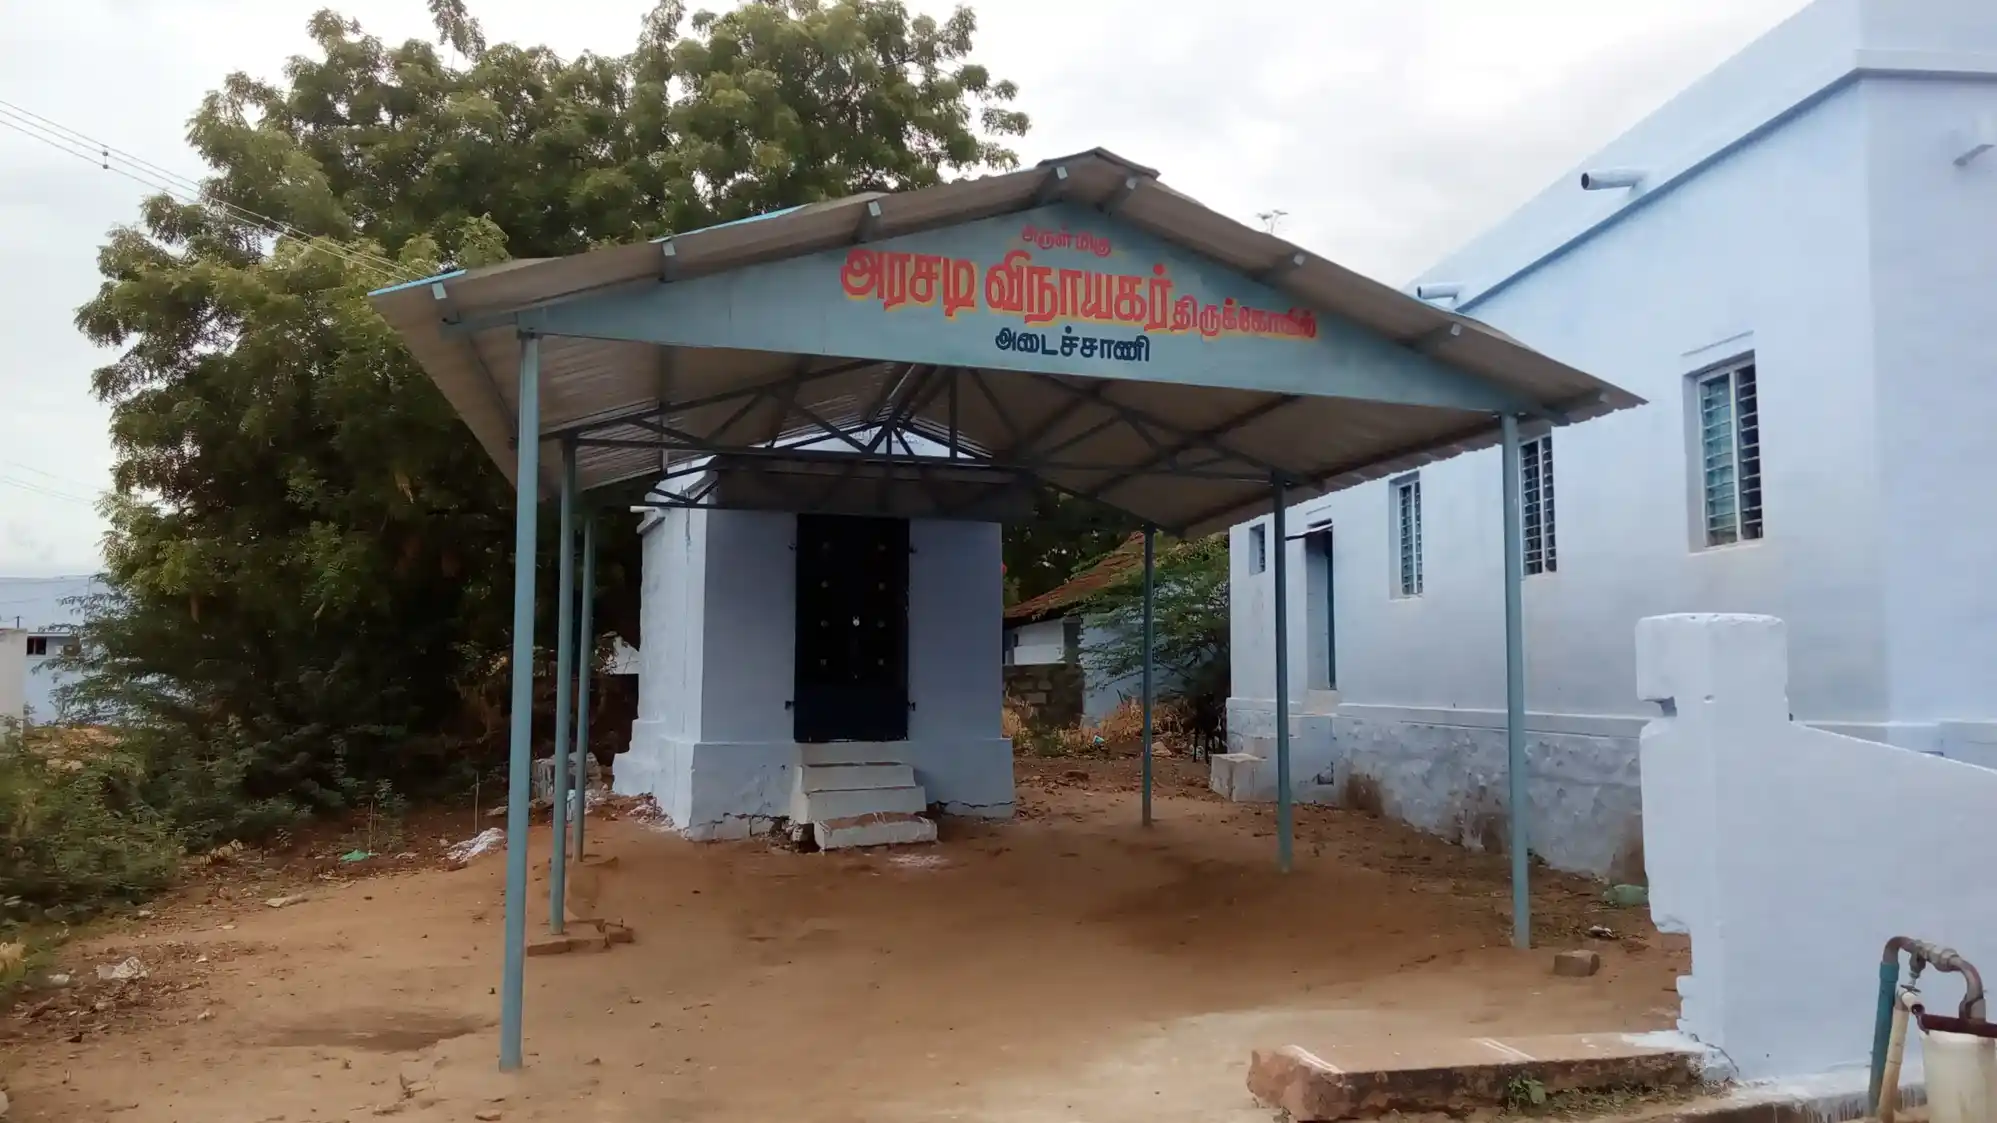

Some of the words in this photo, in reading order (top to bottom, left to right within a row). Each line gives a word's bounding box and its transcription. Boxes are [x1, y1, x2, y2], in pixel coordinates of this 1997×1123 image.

[840, 248, 977, 317] அரசடி
[985, 250, 1173, 332] விநாயகர்
[995, 325, 1150, 362] அடைச்சாணி
